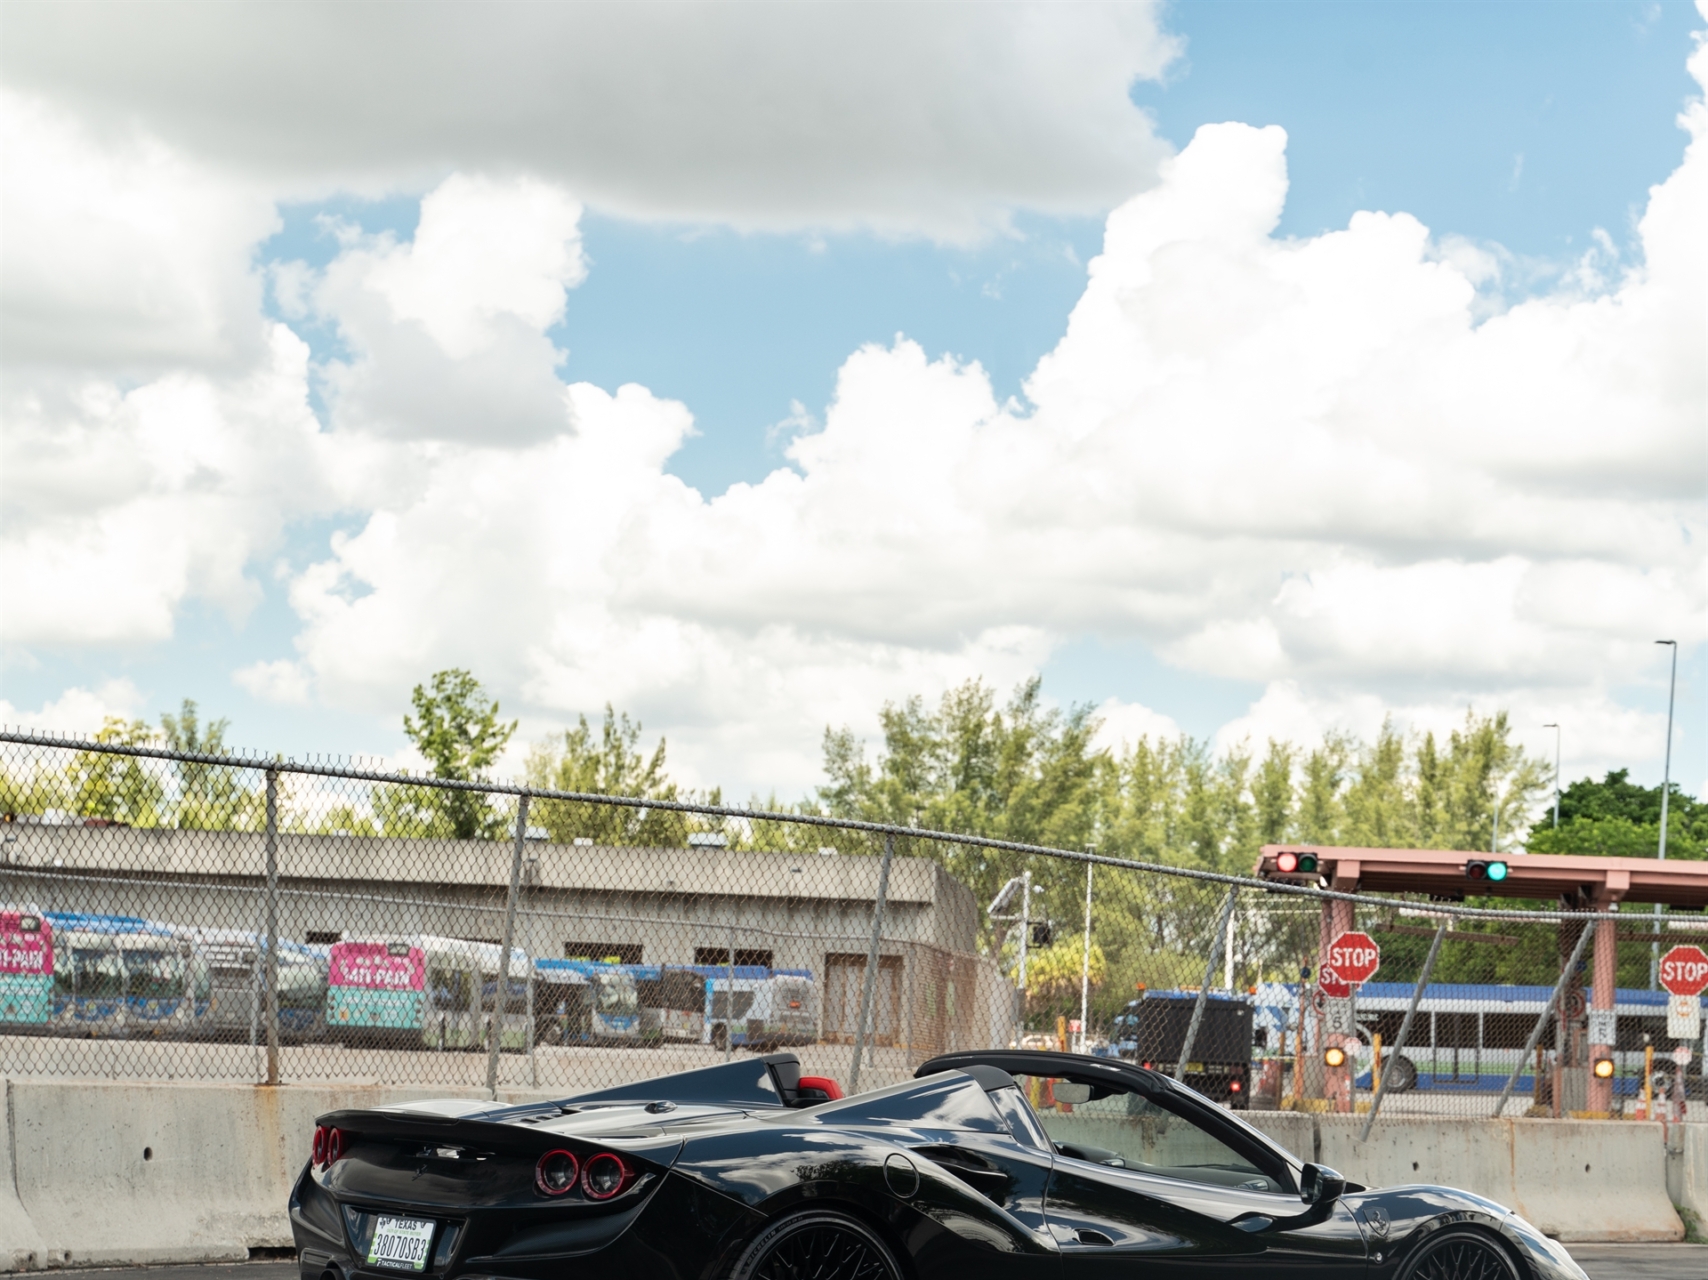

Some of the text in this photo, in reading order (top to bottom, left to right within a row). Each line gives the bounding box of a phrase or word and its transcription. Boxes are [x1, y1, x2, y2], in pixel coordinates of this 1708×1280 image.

[1331, 947, 1376, 967] STOP
[1663, 961, 1708, 982] STOP
[394, 1219, 417, 1230] TEXAS
[374, 1234, 426, 1260] 38070SB3
[747, 1229, 777, 1265] MICHELIN
